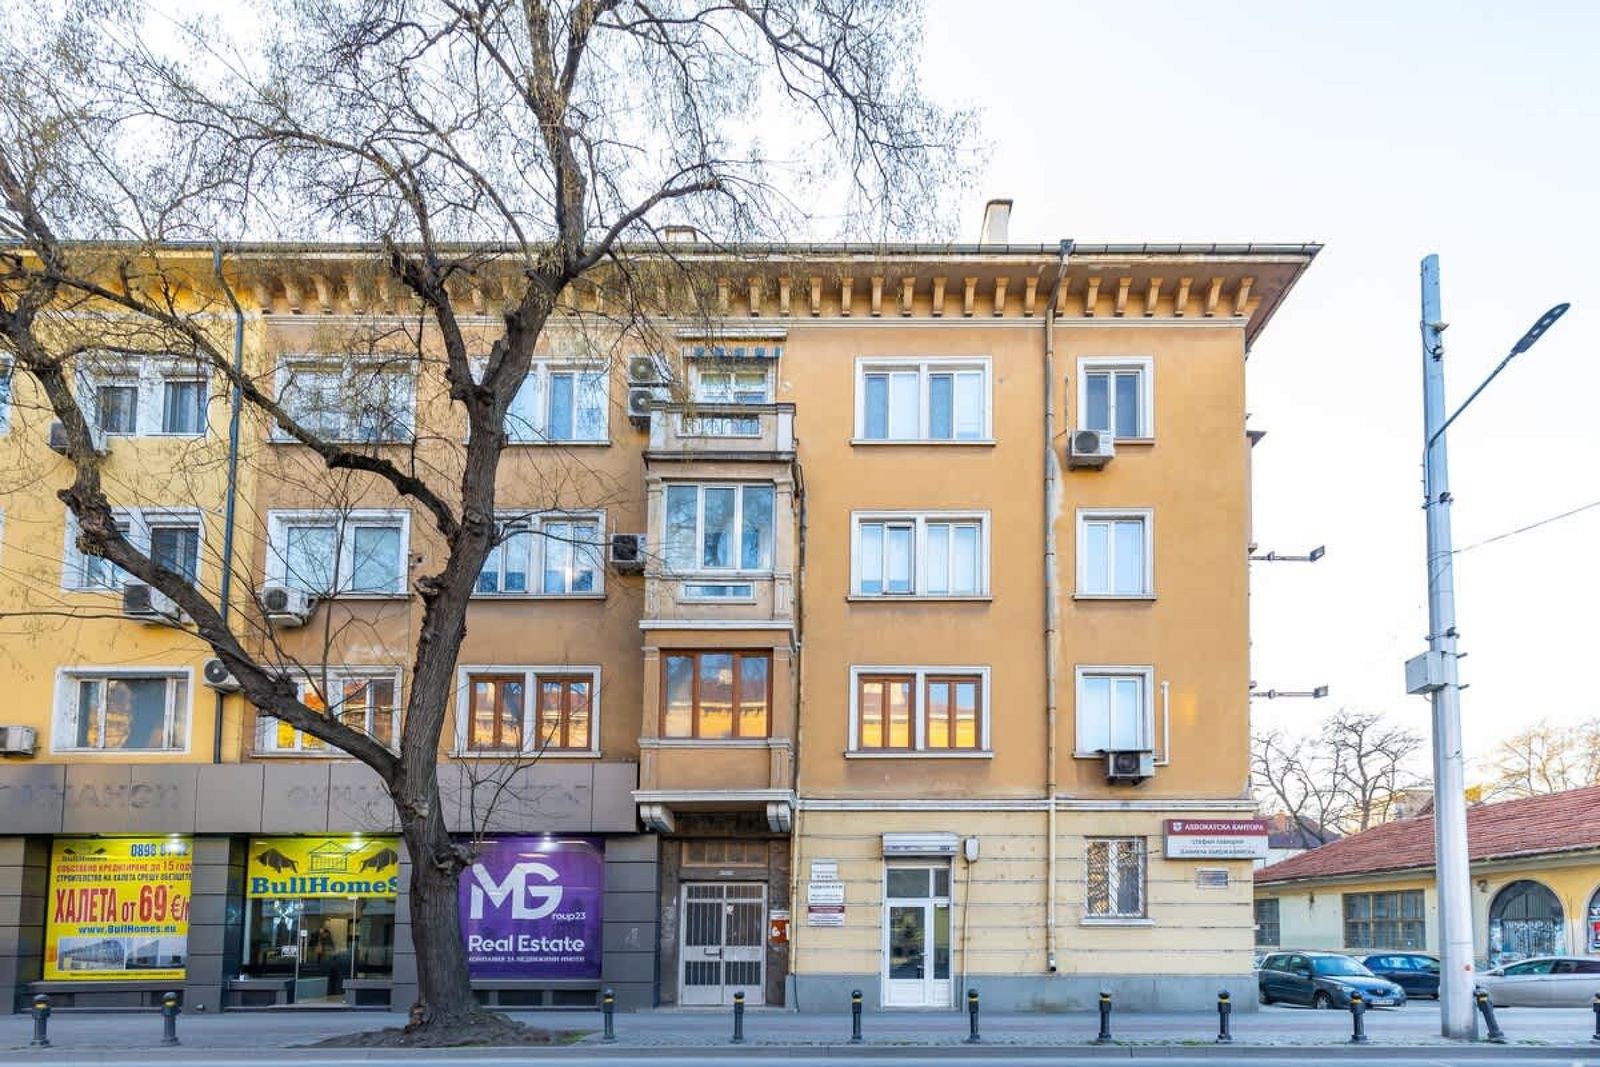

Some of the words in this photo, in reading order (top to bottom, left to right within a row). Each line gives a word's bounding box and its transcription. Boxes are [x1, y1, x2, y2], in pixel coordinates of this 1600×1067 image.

[163, 860, 175, 872] 15
[55, 888, 117, 923] ХАЛЕТА
[78, 925, 177, 934] www.BullHomes.eu
[468, 934, 513, 952] Real
[517, 935, 585, 952] Estate
